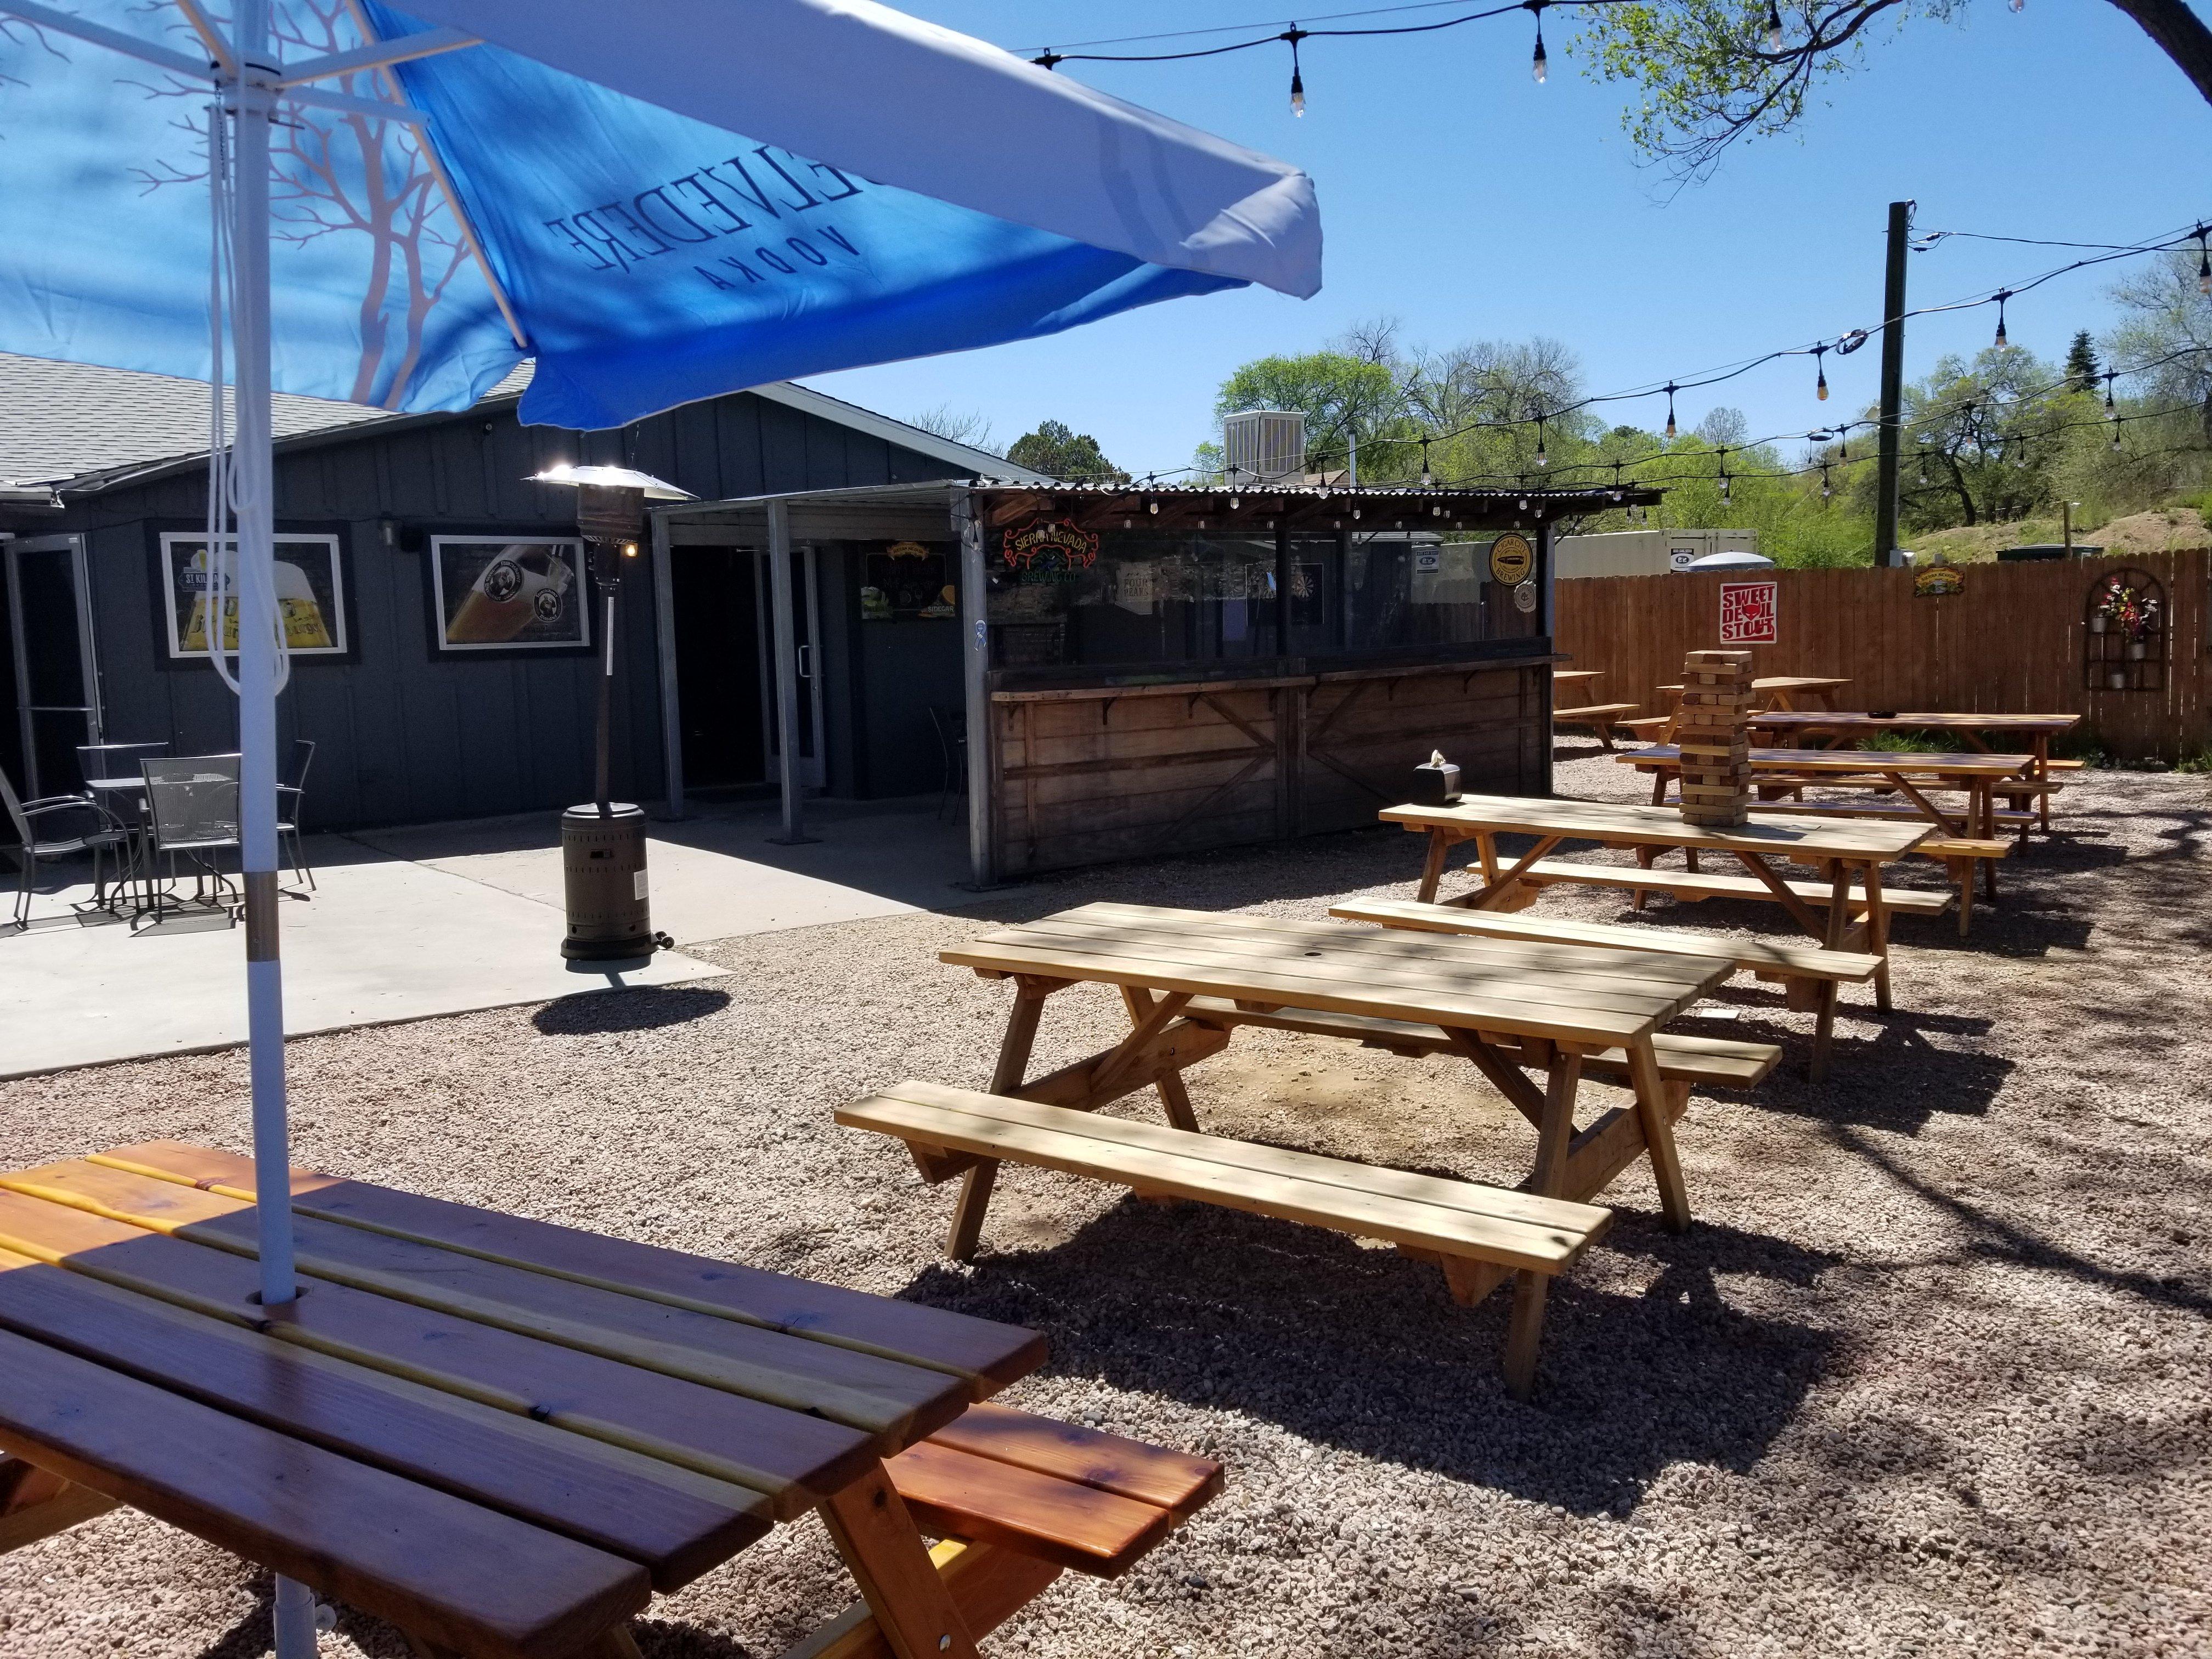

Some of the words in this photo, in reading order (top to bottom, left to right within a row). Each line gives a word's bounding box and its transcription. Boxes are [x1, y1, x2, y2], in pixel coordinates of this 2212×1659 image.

[1050, 531, 1087, 554] NEVADA
[1497, 539, 1514, 552] CIGAR
[1514, 540, 1527, 552] CITY
[1124, 579, 1148, 588] FOUR
[1496, 567, 1525, 582] BREWING
[1723, 585, 1775, 608] SWEET
[1722, 617, 1775, 639] STOUT
